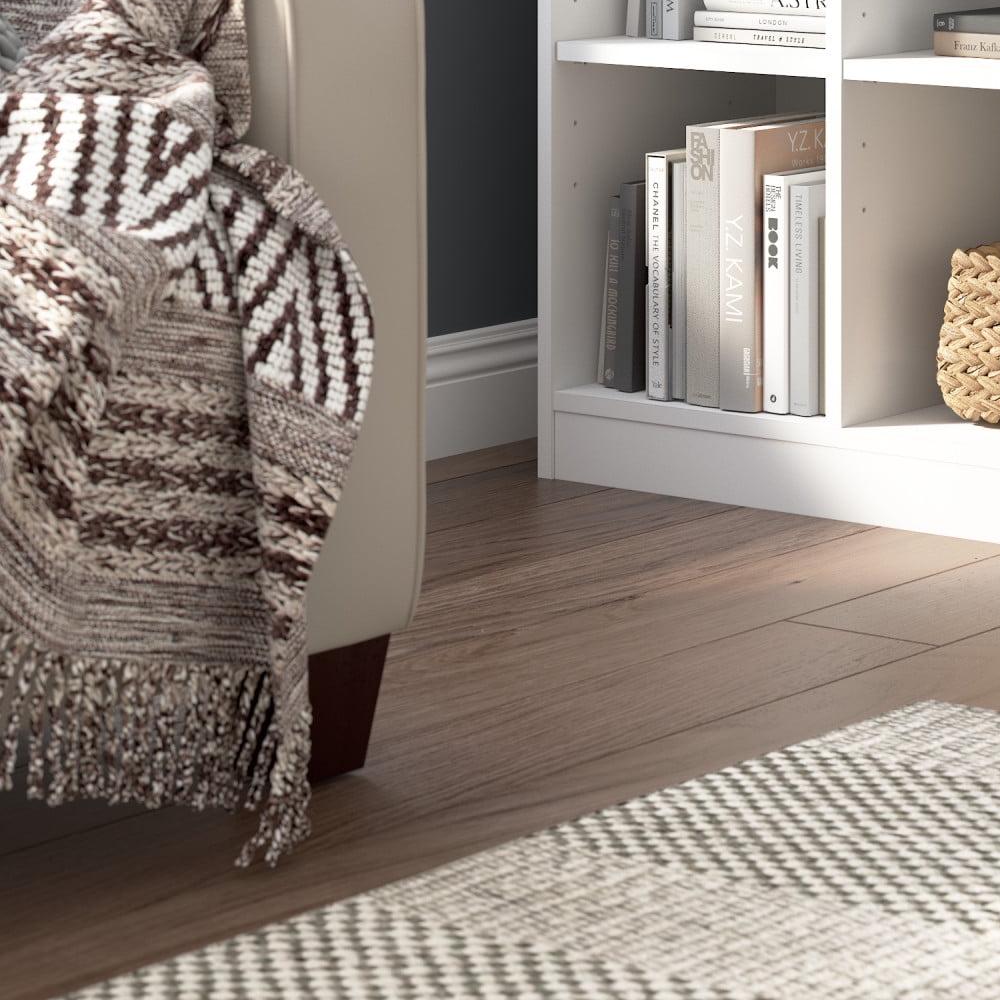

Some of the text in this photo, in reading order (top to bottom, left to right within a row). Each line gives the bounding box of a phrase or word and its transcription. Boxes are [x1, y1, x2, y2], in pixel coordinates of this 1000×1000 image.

[953, 40, 977, 51] Franz
[795, 195, 803, 240] TIMELESS
[795, 243, 803, 274] LIVING
[652, 254, 660, 319] VOCABULARY
[725, 257, 743, 323] KAMI
[652, 322, 660, 336] OF
[652, 338, 660, 368] STYLE
